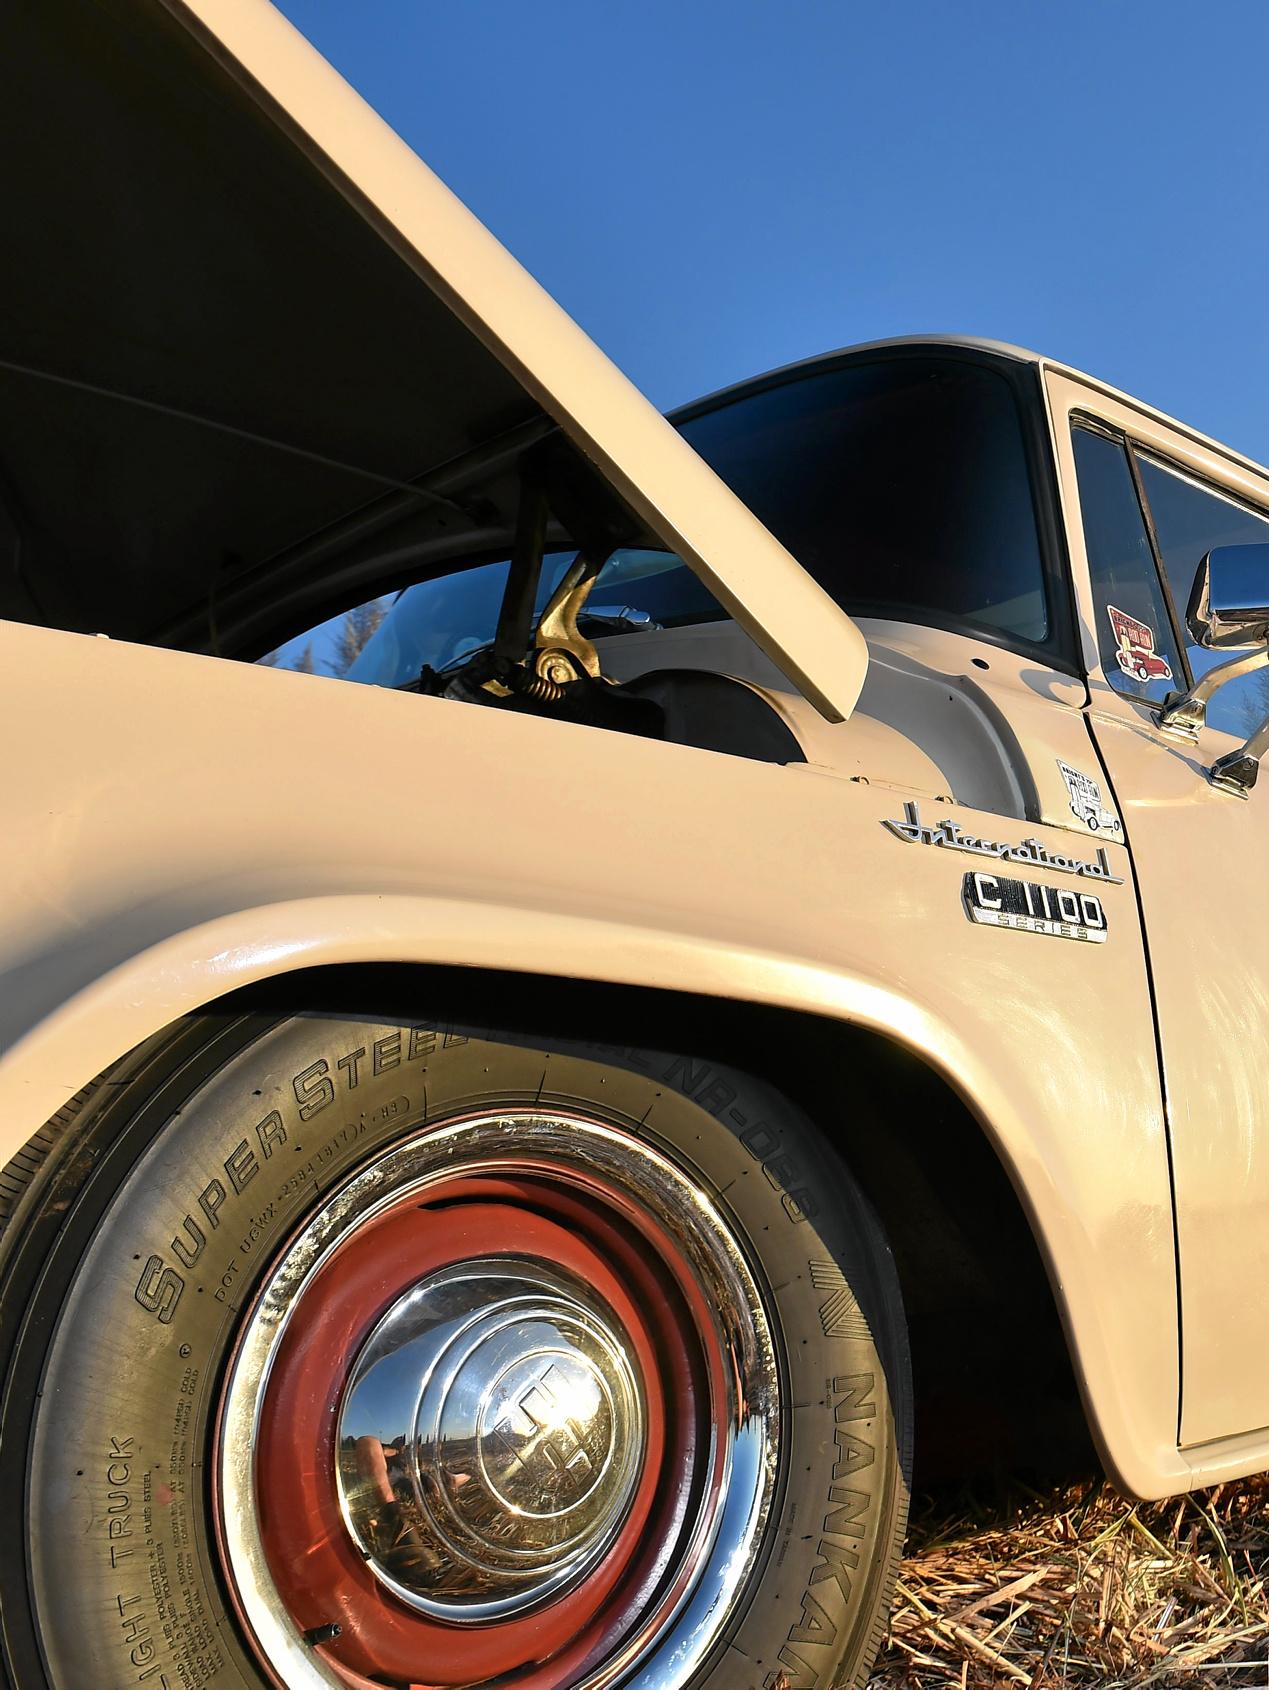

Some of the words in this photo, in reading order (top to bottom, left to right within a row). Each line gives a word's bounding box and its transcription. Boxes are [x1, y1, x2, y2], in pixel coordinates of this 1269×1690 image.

[879, 800, 1126, 885] International
[974, 872, 1001, 909] C
[1023, 882, 1103, 928] 1100
[997, 914, 1088, 939] SERIES
[135, 1110, 287, 1324] SUPER
[293, 1016, 469, 1121] STEEL
[215, 1258, 239, 1302] DOT
[108, 1436, 134, 1569] TRUCK
[143, 1471, 151, 1502] STEEL
[150, 1563, 166, 1620] POLYESTER
